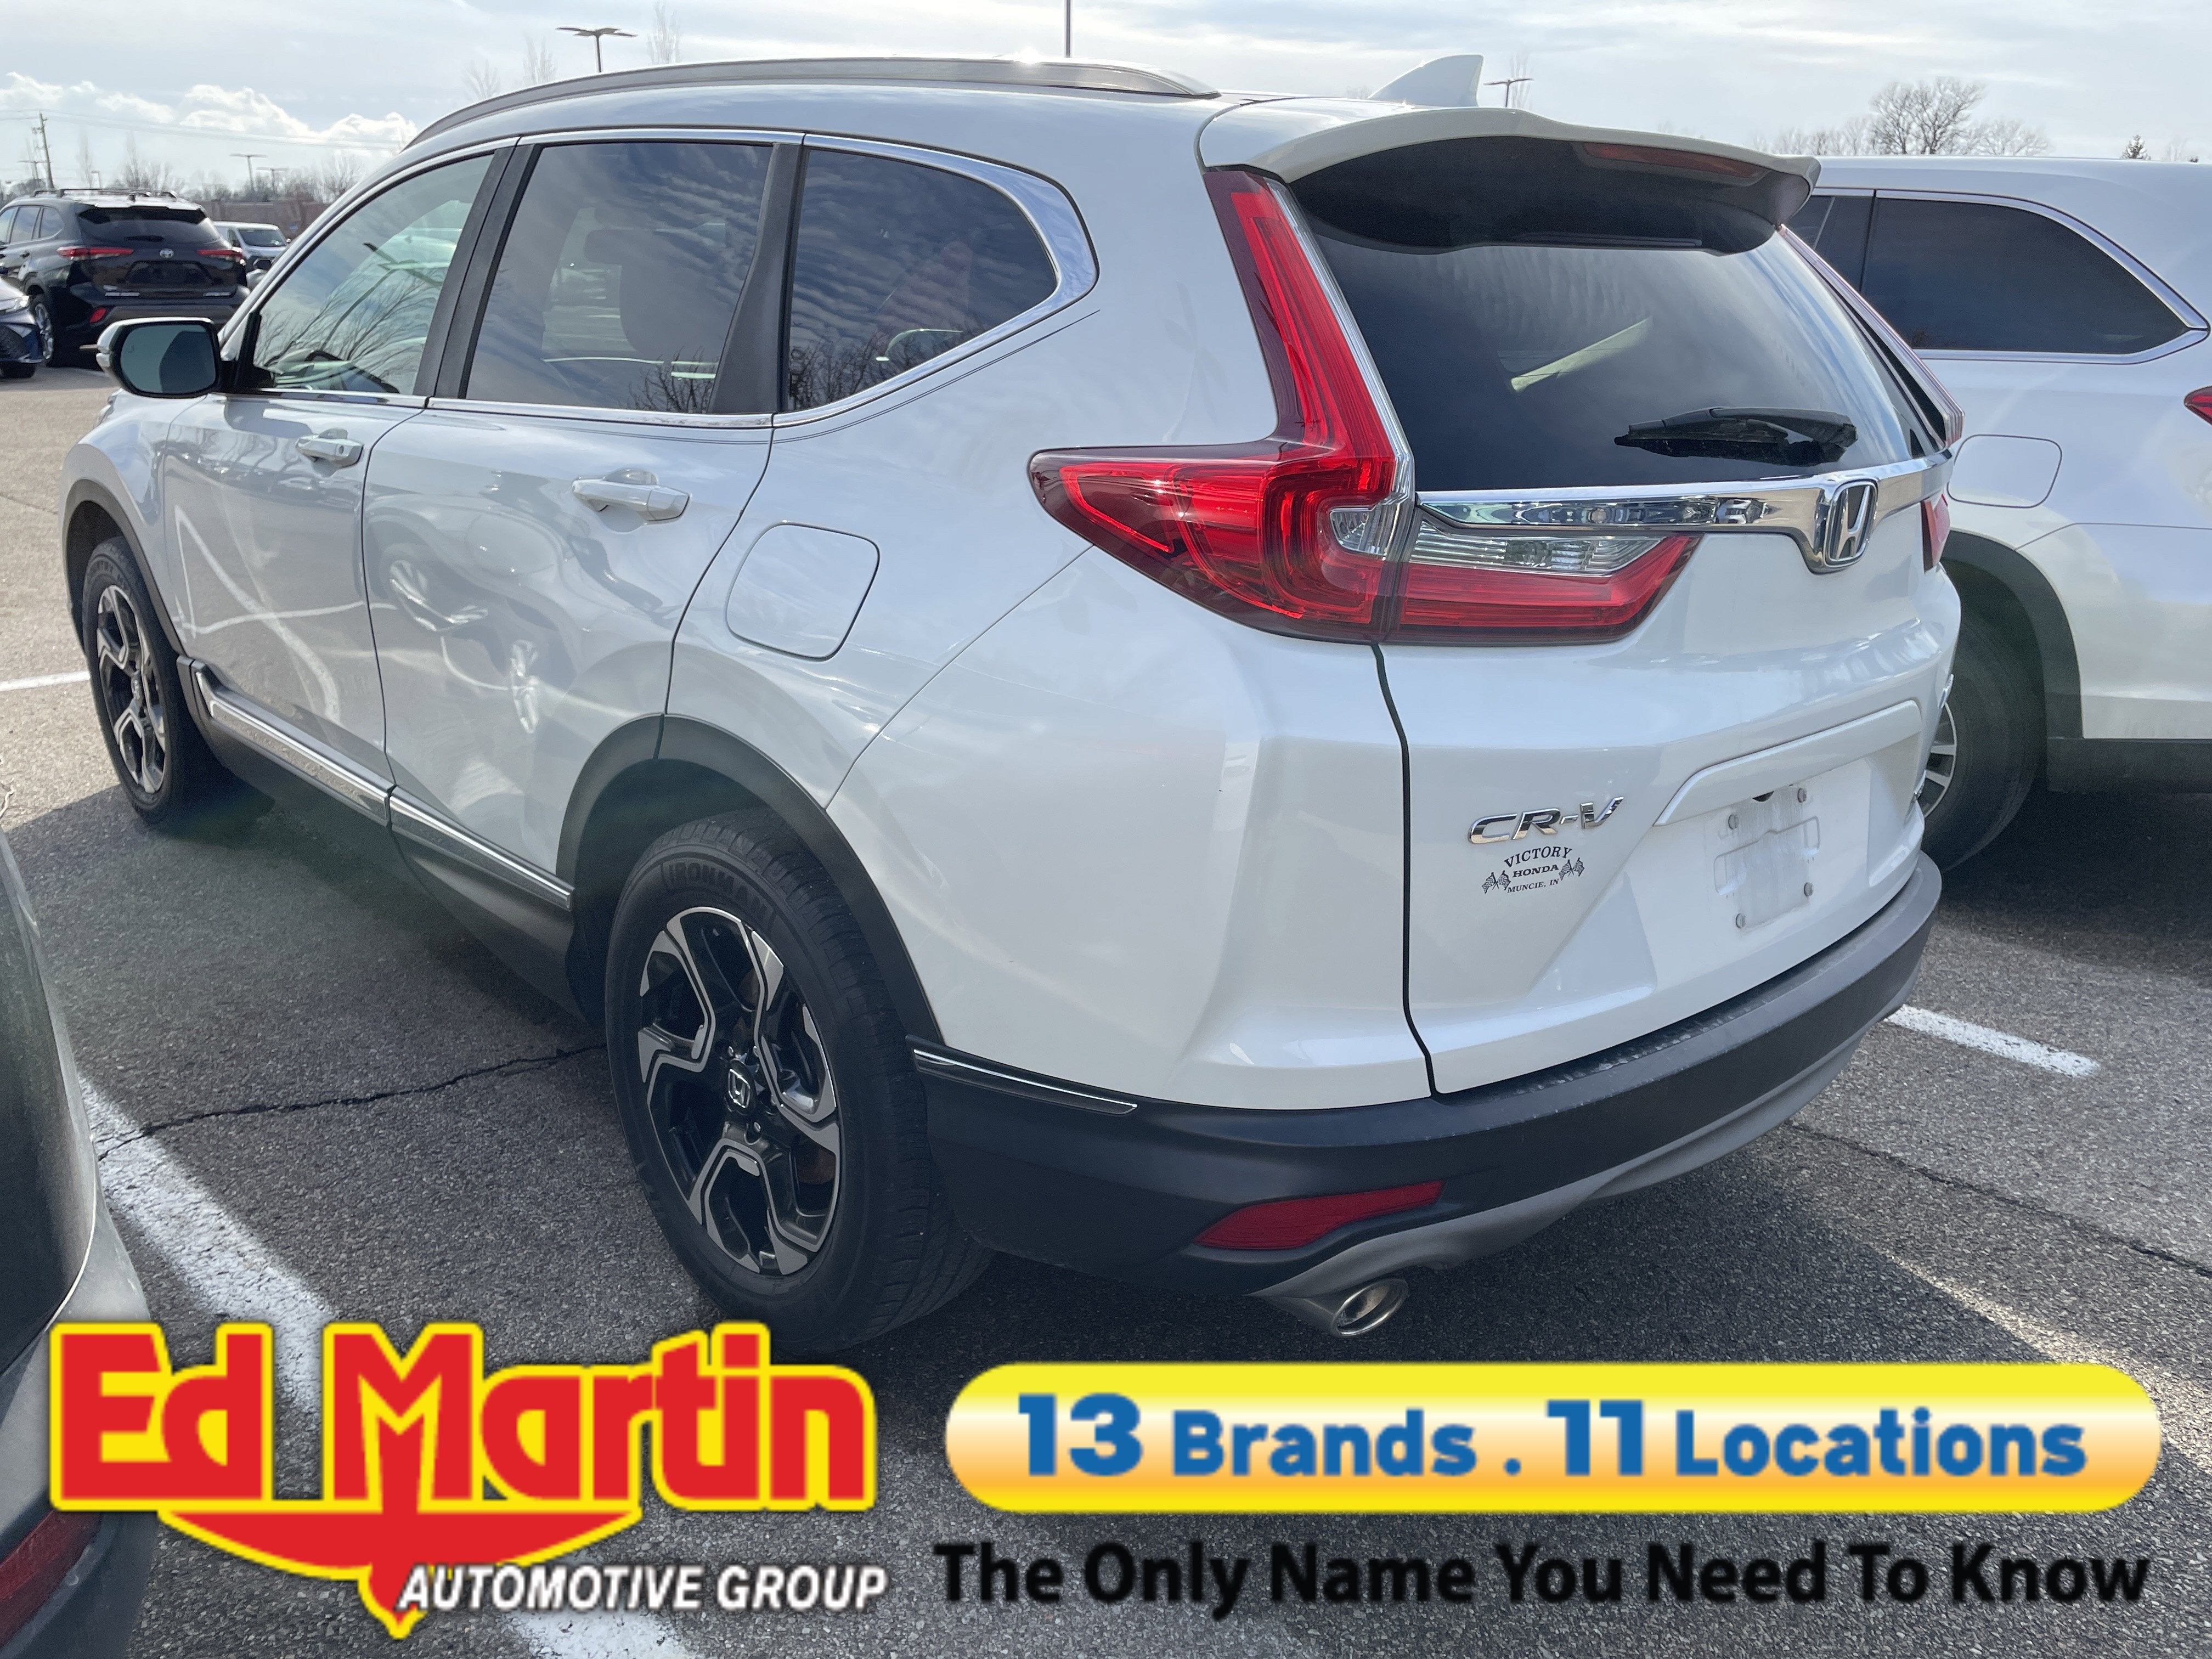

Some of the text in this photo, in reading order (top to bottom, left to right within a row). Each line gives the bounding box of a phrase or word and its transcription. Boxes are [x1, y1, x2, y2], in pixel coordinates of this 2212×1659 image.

[1468, 795, 1624, 844] CR-V
[1504, 846, 1572, 868] VICTORY
[1513, 864, 1559, 878] HONDA
[668, 862, 769, 919] IRONMAN
[1506, 878, 1560, 893] MUNCIE, IN
